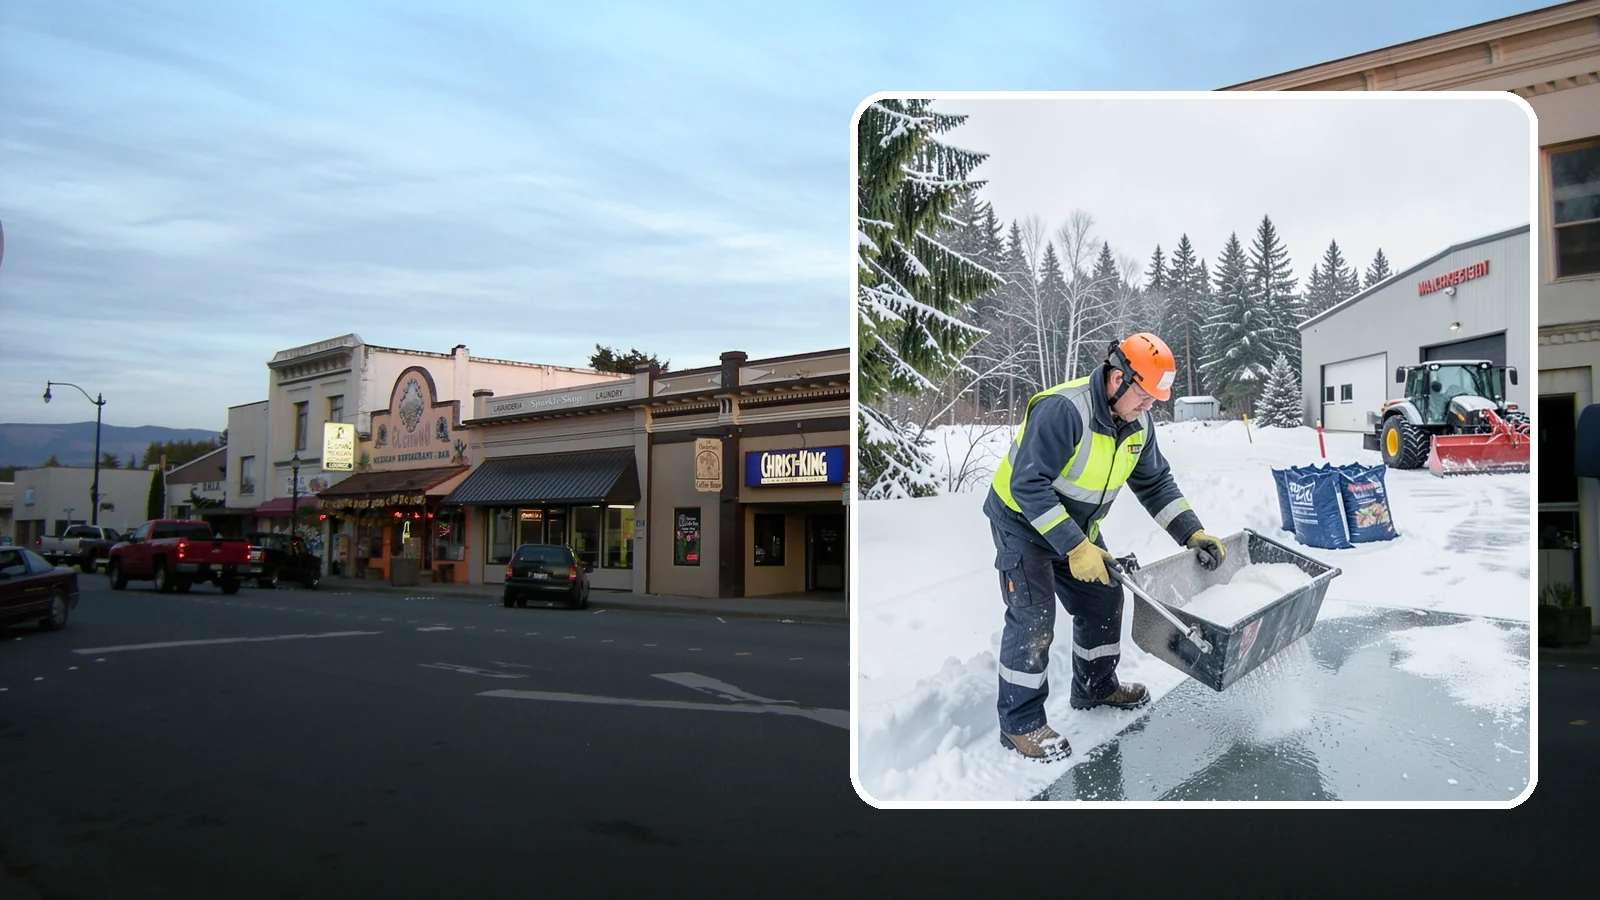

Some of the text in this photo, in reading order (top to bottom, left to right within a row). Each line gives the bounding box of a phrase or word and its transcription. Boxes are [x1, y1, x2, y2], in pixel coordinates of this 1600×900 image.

[562, 394, 582, 404] Shop
[595, 389, 623, 400] LAUNDRY
[493, 402, 523, 412] LAVANDERIA
[373, 455, 396, 464] MEXICAN
[397, 451, 434, 462] RESTAURANT
[438, 450, 450, 459] BAR
